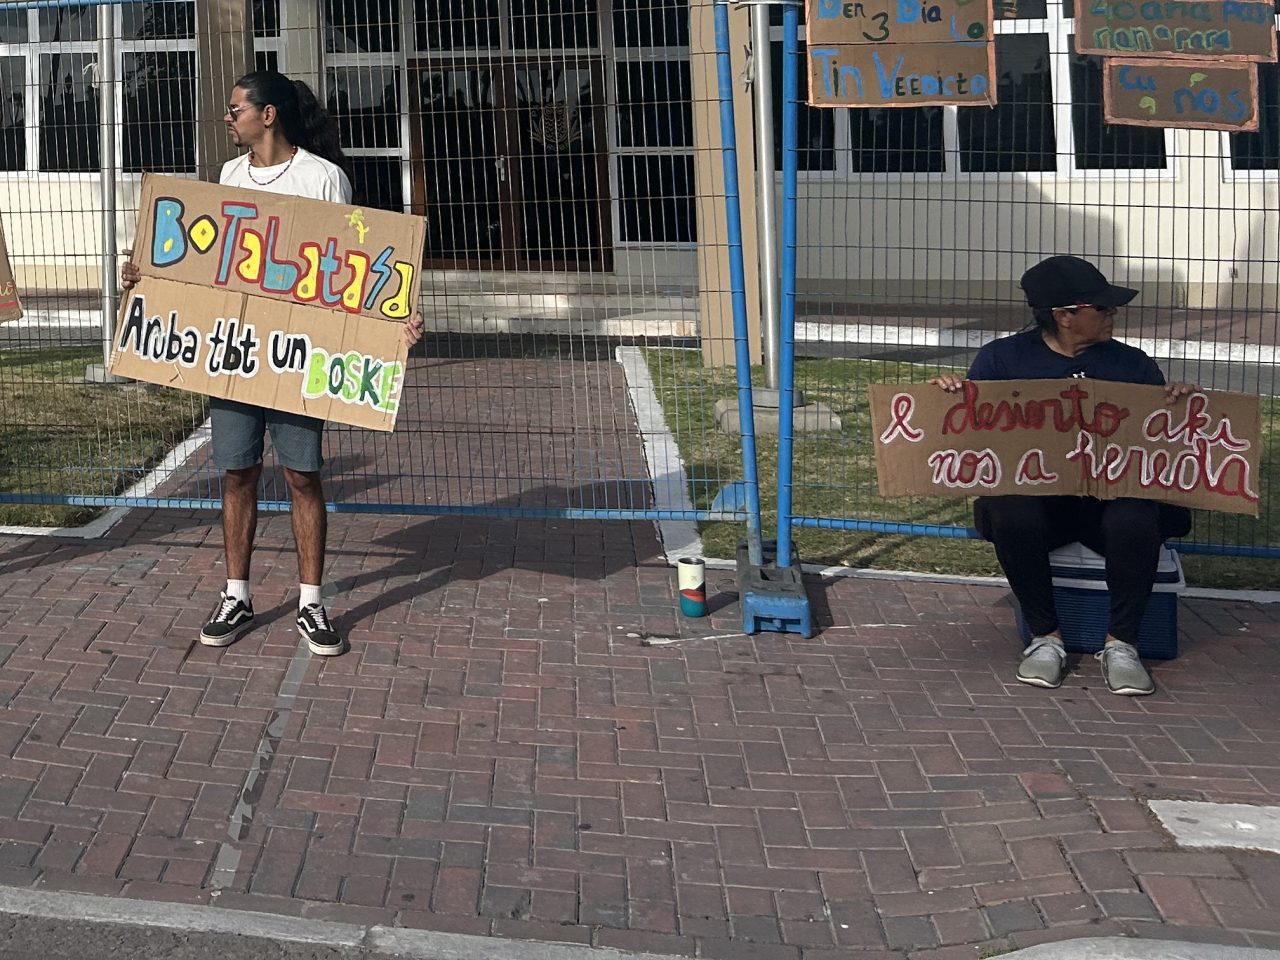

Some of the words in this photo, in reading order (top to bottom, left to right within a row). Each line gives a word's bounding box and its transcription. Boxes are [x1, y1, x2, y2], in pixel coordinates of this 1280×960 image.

[863, 12, 890, 41] 3
[812, 48, 864, 99] Tin
[119, 294, 202, 368] Aruba
[206, 318, 261, 378] tbt
[268, 331, 311, 373] un
[302, 348, 404, 412] BOSKE
[1142, 393, 1252, 452] aki
[928, 448, 1002, 489] nos
[1015, 448, 1058, 486] a
